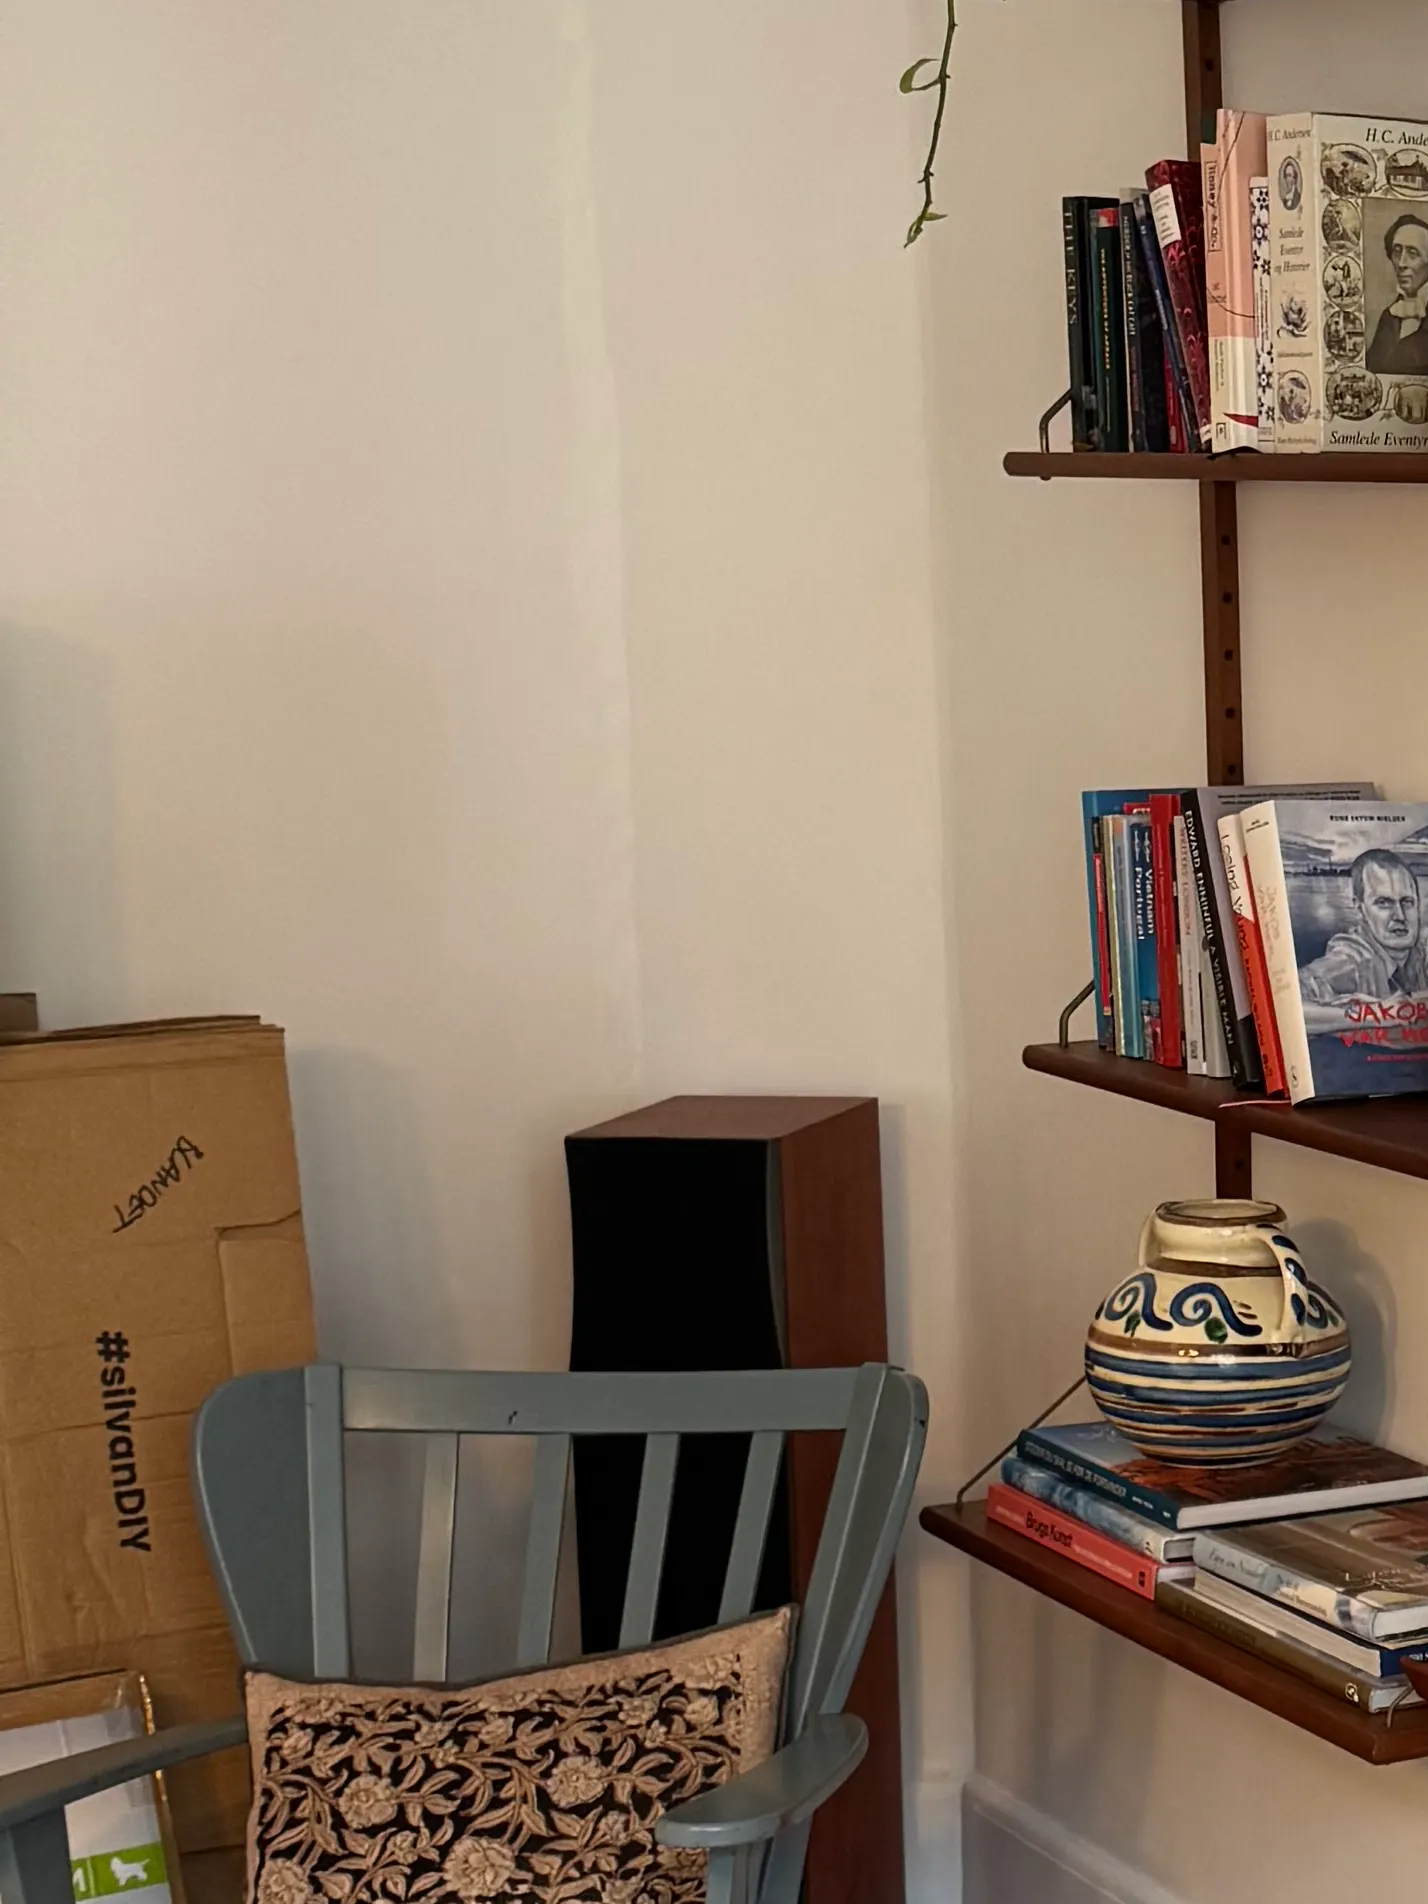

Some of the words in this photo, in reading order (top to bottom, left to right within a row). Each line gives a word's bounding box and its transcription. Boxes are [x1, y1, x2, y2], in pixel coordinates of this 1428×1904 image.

[1366, 127, 1395, 145] H.C.
[1136, 867, 1145, 940] Portugal
[1145, 868, 1153, 935] Vietnam
[1184, 809, 1200, 868] EDWARD
[1198, 872, 1214, 942] ENNINFUL
[95, 1330, 151, 1552] #silvanDIY
